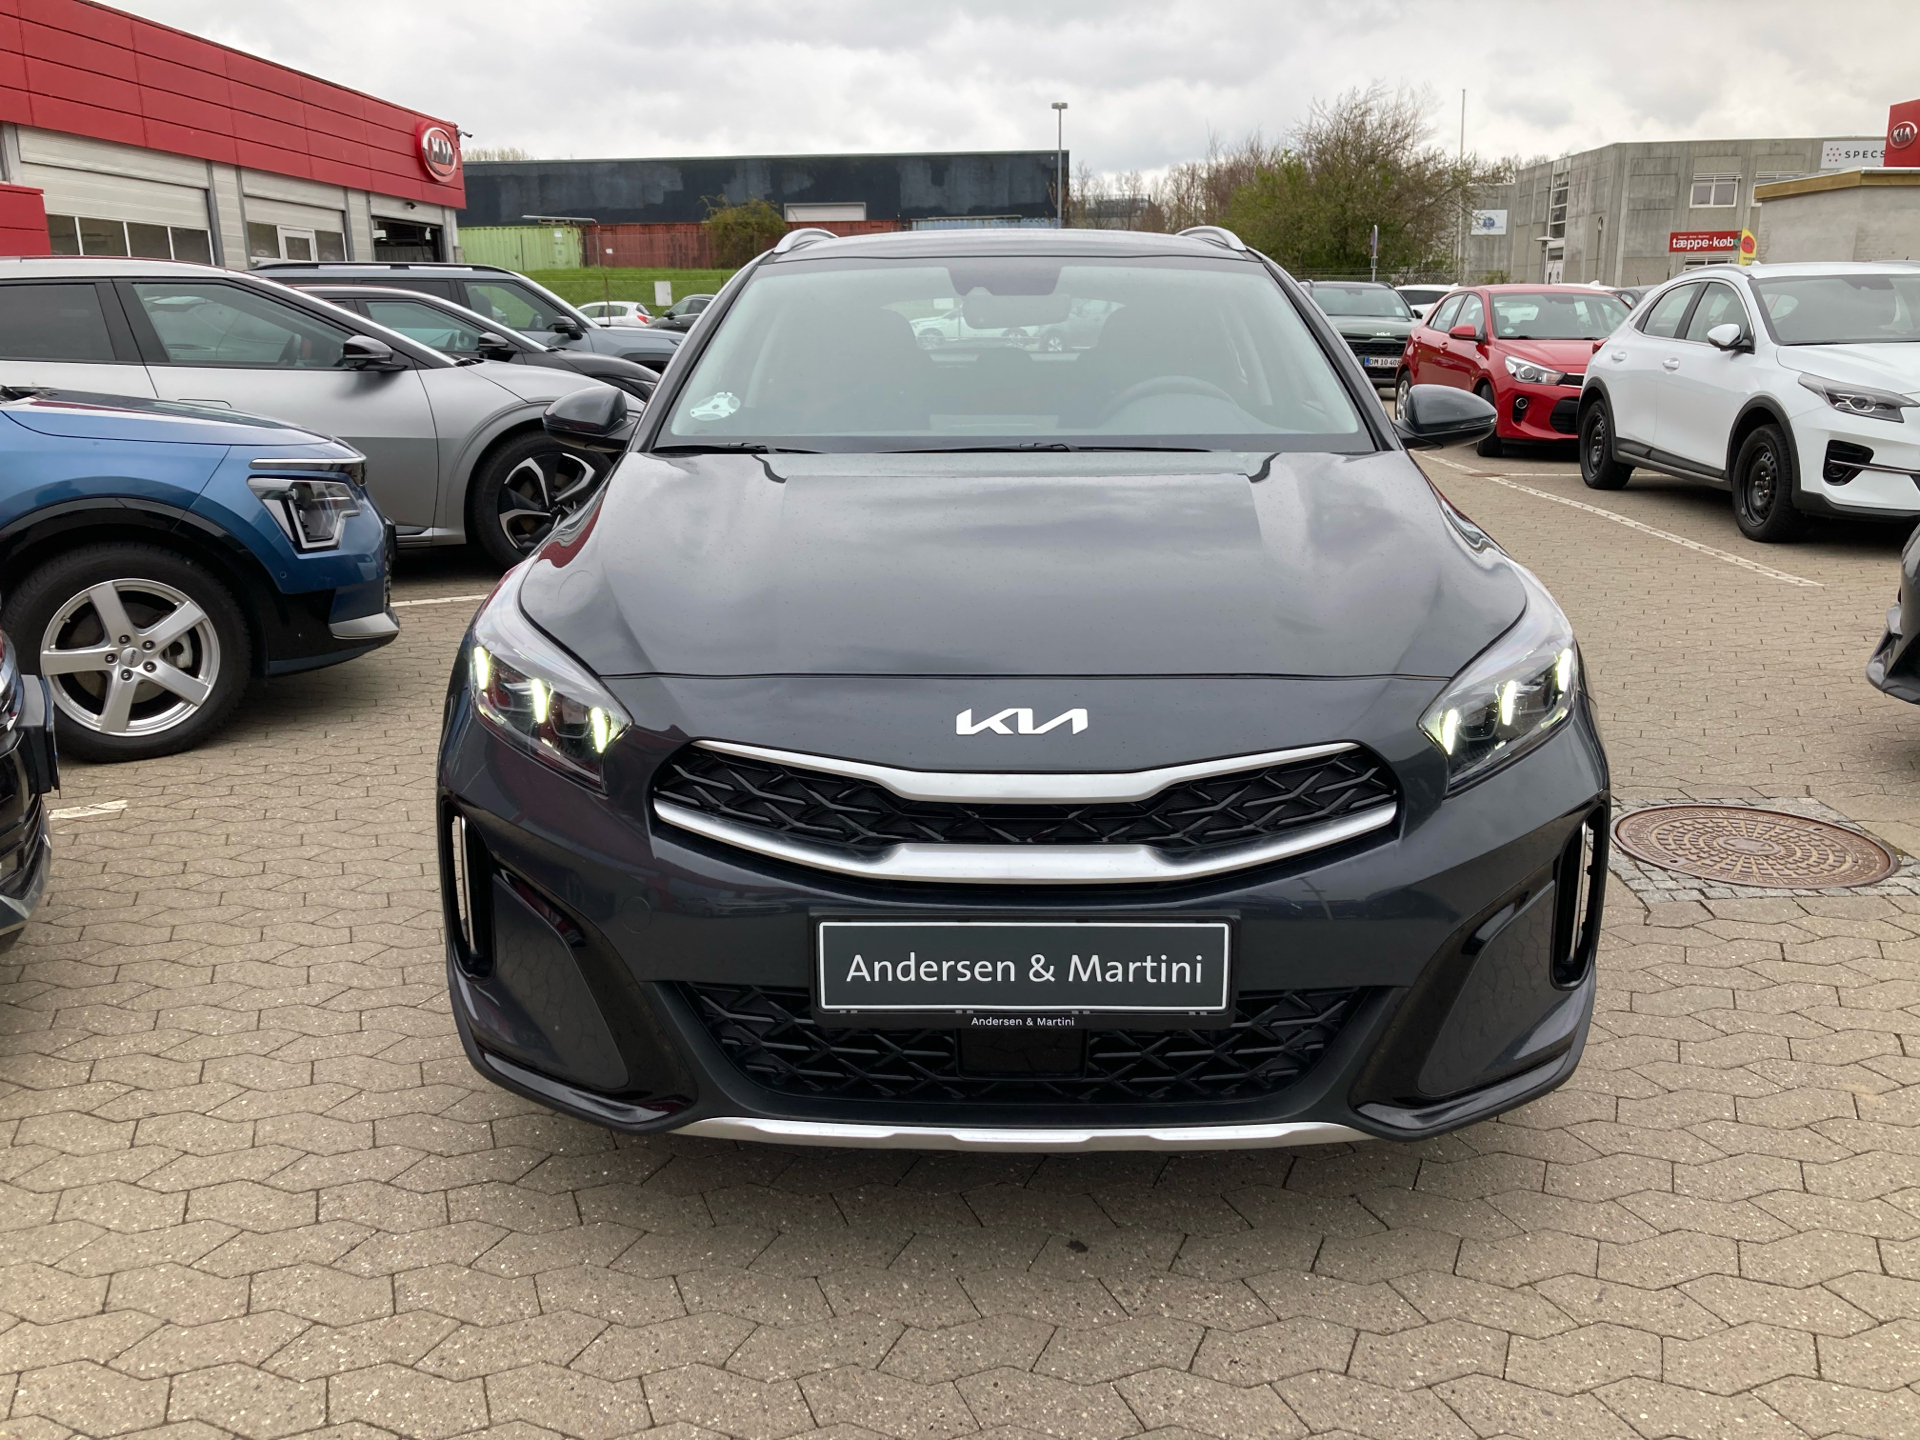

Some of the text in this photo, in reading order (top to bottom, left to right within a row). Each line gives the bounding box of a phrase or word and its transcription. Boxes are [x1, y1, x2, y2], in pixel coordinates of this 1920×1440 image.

[1893, 127, 1912, 142] KIA
[956, 708, 1088, 735] KIA
[846, 952, 1202, 984] Andersen & Martini
[971, 1017, 1074, 1026] Andersen & Martini
